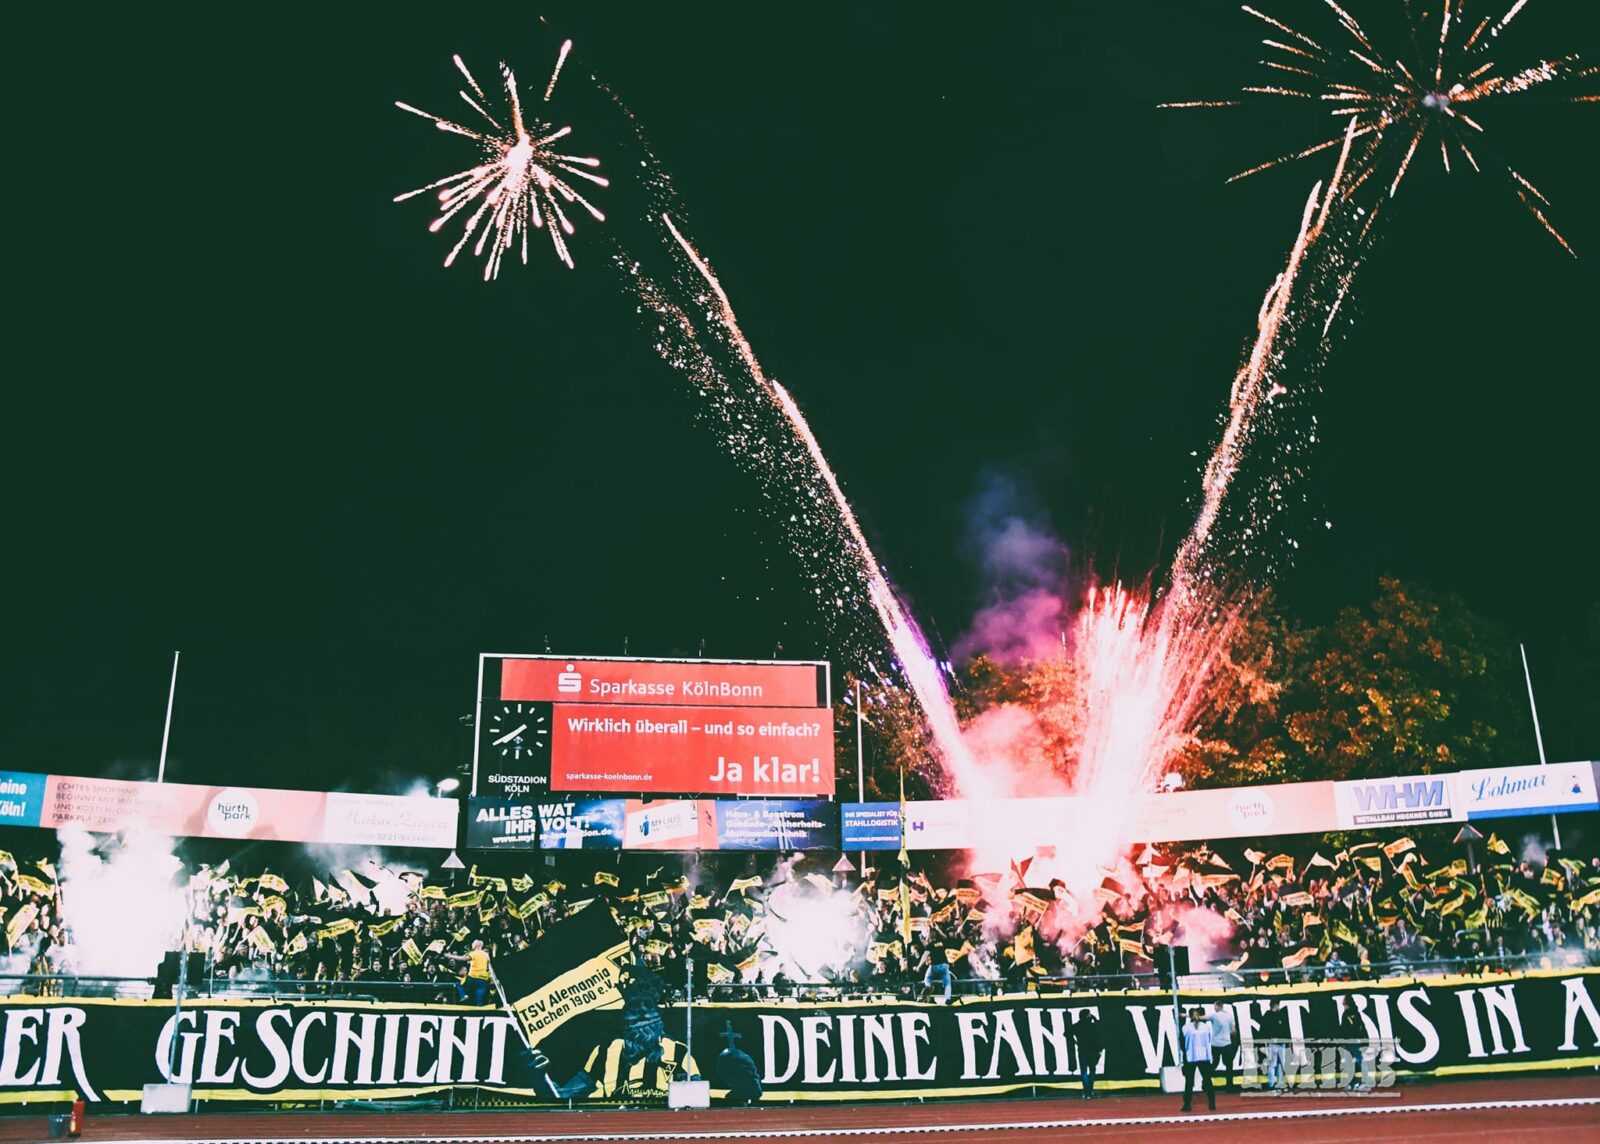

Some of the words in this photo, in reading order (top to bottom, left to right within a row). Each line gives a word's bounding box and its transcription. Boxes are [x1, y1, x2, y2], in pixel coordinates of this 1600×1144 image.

[589, 679, 675, 697] Sparkasse
[682, 680, 763, 697] KölnBonn
[567, 717, 631, 734] Wirklich
[635, 719, 688, 735] überall
[705, 721, 734, 736] und
[737, 724, 755, 736] so
[759, 722, 821, 737] einfach?
[565, 772, 653, 782] sparkasse-koelnbonn.de
[709, 756, 743, 783] Ja
[753, 755, 820, 784] klar!
[0, 778, 27, 795] eine
[57, 782, 90, 792] ECHTES
[488, 774, 547, 784] SÜDSTADION
[1471, 775, 1548, 801] Lohmar
[504, 784, 530, 793] KÖLN
[1353, 780, 1443, 811] WHM
[54, 802, 73, 811] UND
[476, 805, 534, 822] ALLES
[538, 802, 576, 817] WAT
[224, 811, 251, 821] park
[504, 819, 536, 835] IHR
[540, 815, 591, 831] VOLT!
[651, 814, 682, 828] MYLIUS
[844, 819, 899, 827] STAHLLOGISTIK
[518, 1000, 547, 1022] TSV
[548, 967, 611, 1008] Alemannia
[527, 1004, 570, 1034] Aachen
[569, 990, 597, 1008] 1900
[758, 1012, 937, 1084] DEINE
[1455, 983, 1531, 1059] IN
